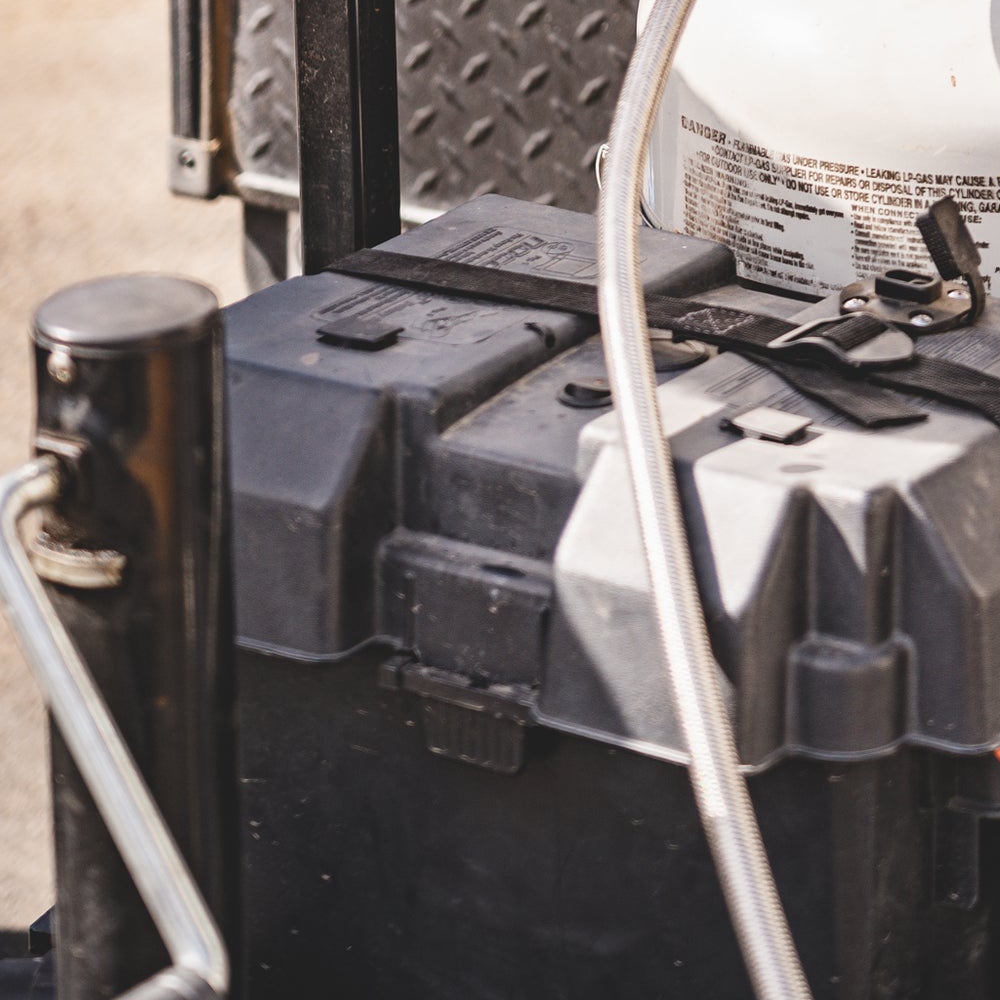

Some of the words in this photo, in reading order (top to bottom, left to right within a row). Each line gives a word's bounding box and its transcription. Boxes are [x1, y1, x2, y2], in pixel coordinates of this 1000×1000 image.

[681, 115, 726, 145] DANGER
[793, 154, 817, 169] UNDER
[820, 160, 860, 176] PRESSURE
[866, 168, 901, 182] LEAKING
[903, 172, 933, 185] LP-GAS
[935, 174, 954, 186] MAY
[956, 175, 986, 187] CAUSE
[988, 176, 995, 187] A
[786, 179, 796, 190] DO
[798, 181, 814, 194] NOT
[814, 185, 830, 197] USE
[831, 188, 842, 199] OR
[844, 190, 869, 203] STORE
[871, 194, 912, 209] CYLINDER
[914, 199, 923, 209] IN
[808, 170, 823, 182] FOR
[825, 174, 856, 189] REPAIRS
[858, 179, 870, 190] OR
[872, 181, 913, 195] DISPOSAL
[915, 186, 925, 197] OF
[926, 186, 946, 198] THIS
[948, 187, 994, 200] CYLINDER
[851, 204, 875, 214] WHEN
